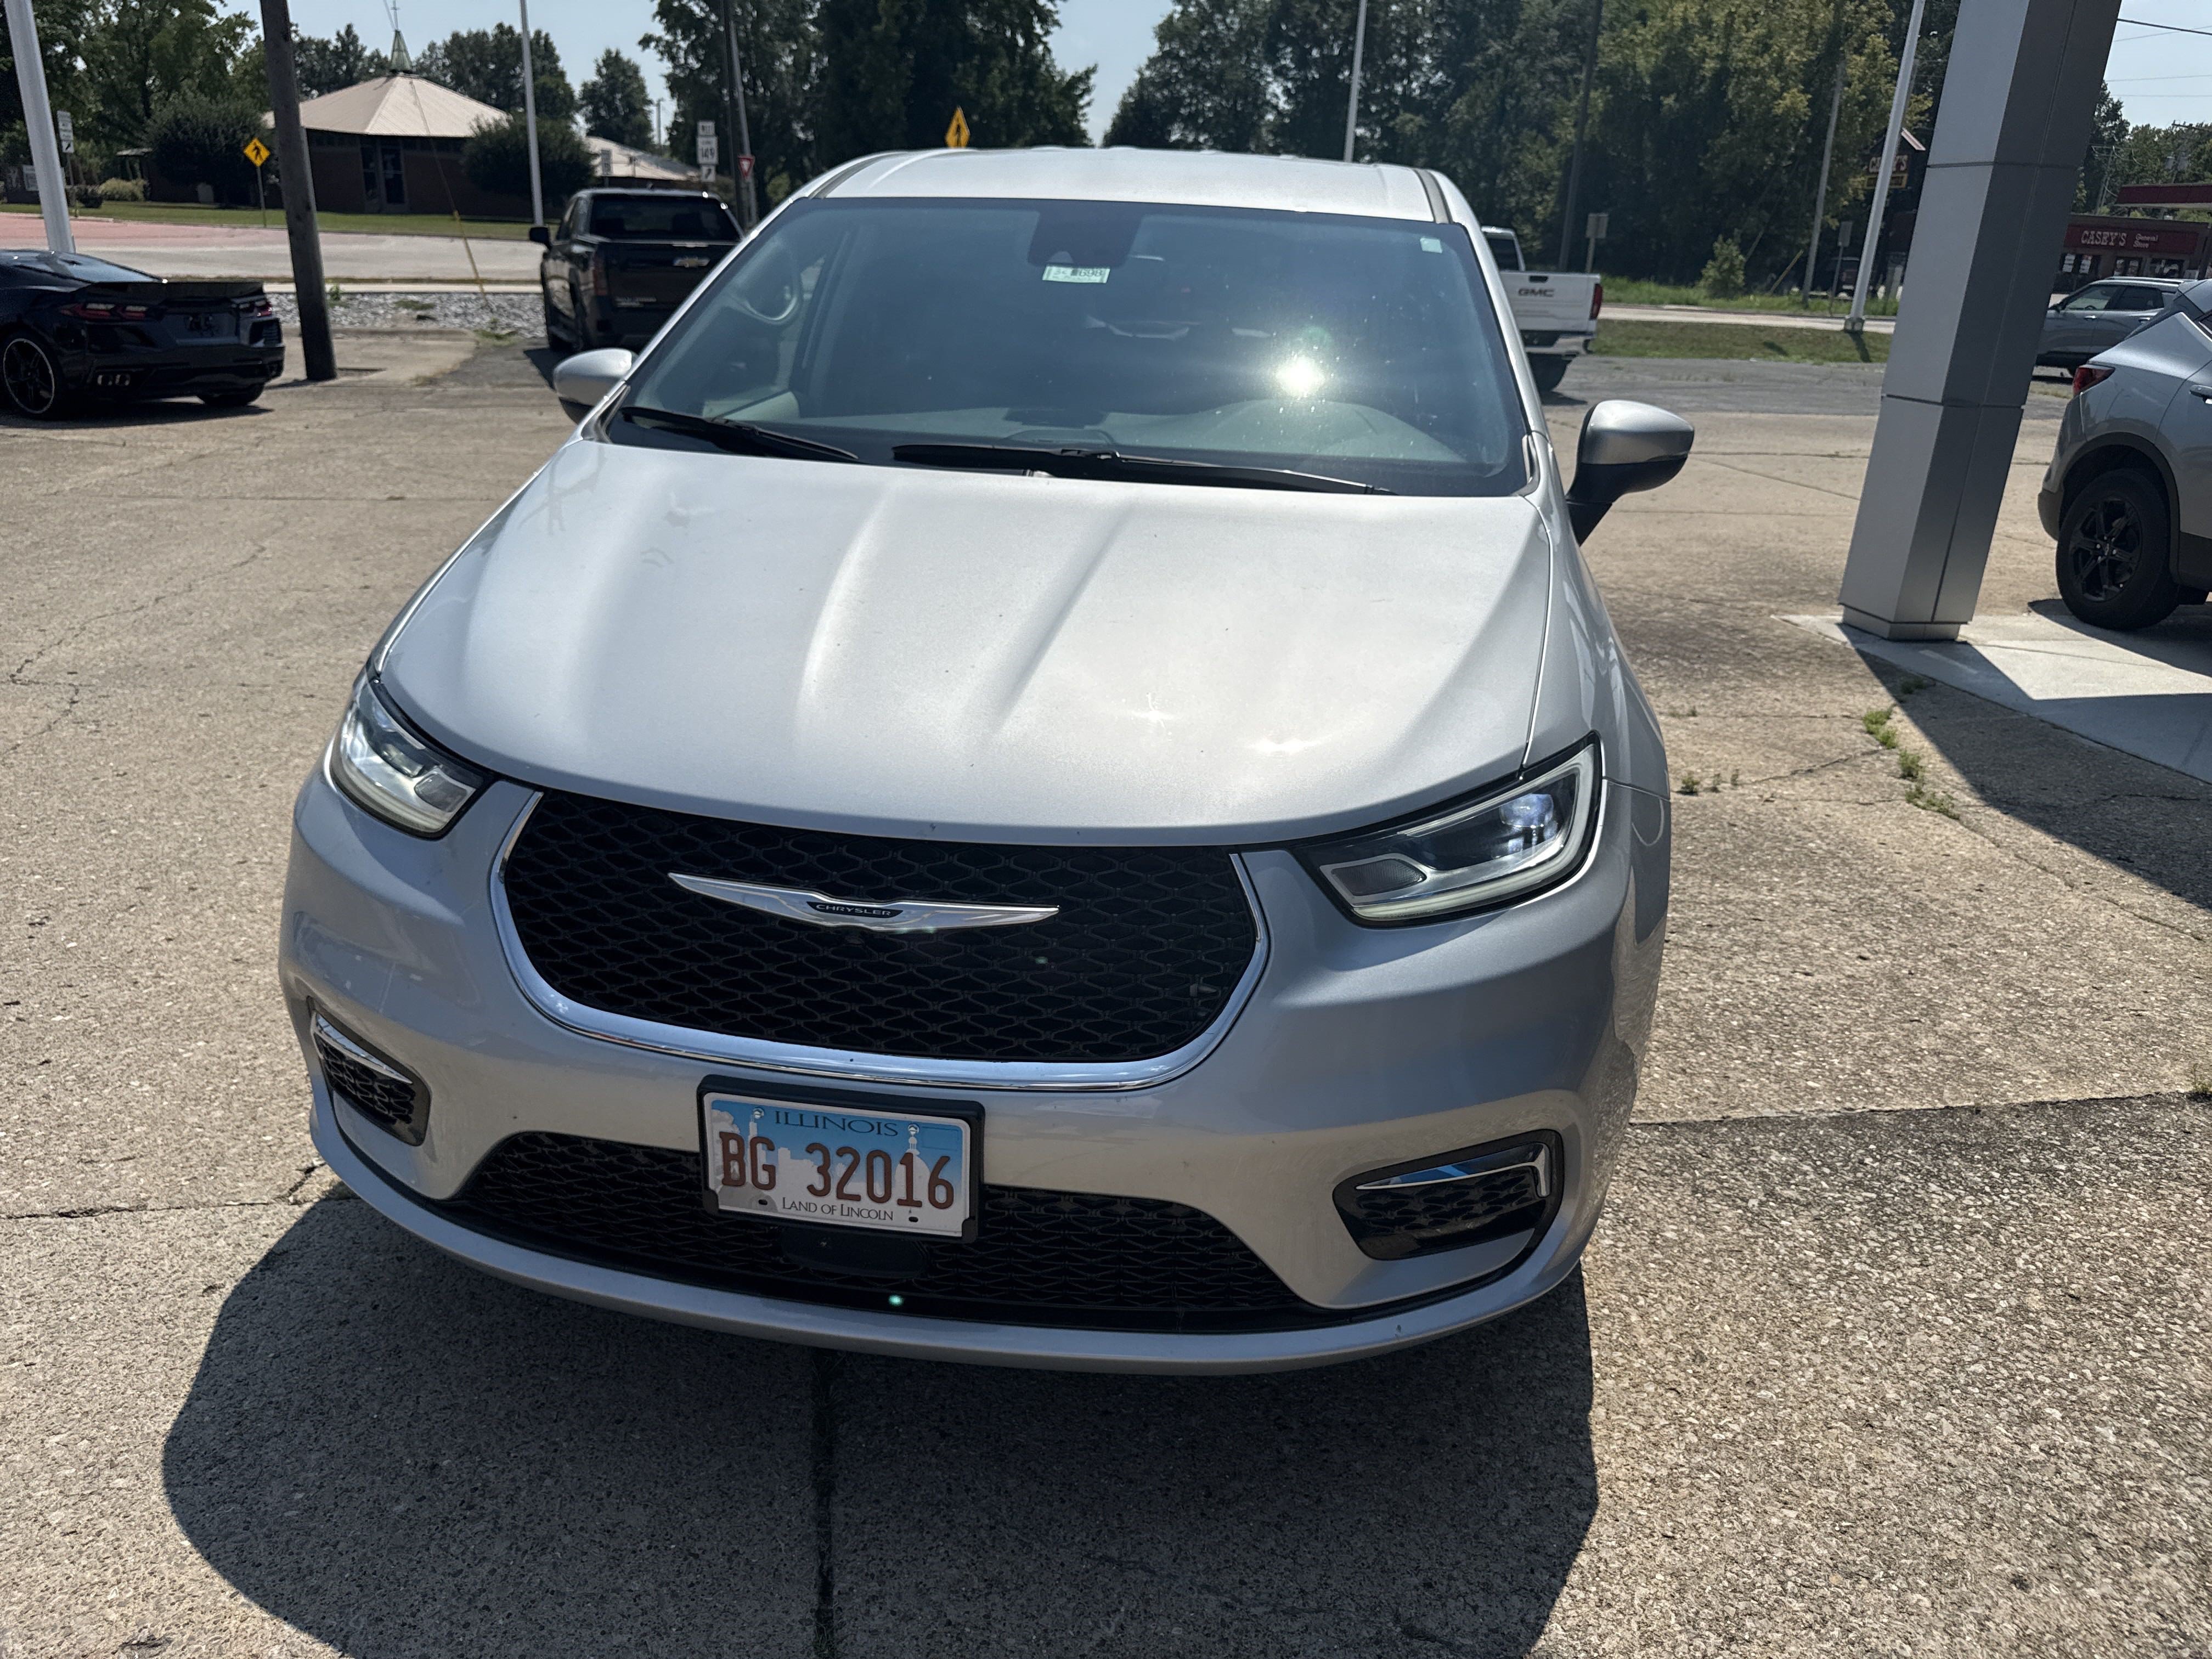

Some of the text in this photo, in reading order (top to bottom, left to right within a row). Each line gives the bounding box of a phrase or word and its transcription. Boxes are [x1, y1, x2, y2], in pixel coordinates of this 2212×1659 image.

[2081, 230, 2127, 246] CASEY'S
[1518, 289, 1555, 297] GMC
[816, 904, 891, 916] CHRYSLER
[775, 1110, 899, 1137] ILLINOIS
[719, 1131, 954, 1209] BG 32016
[782, 1197, 894, 1221] LAND OF LINCOLN
